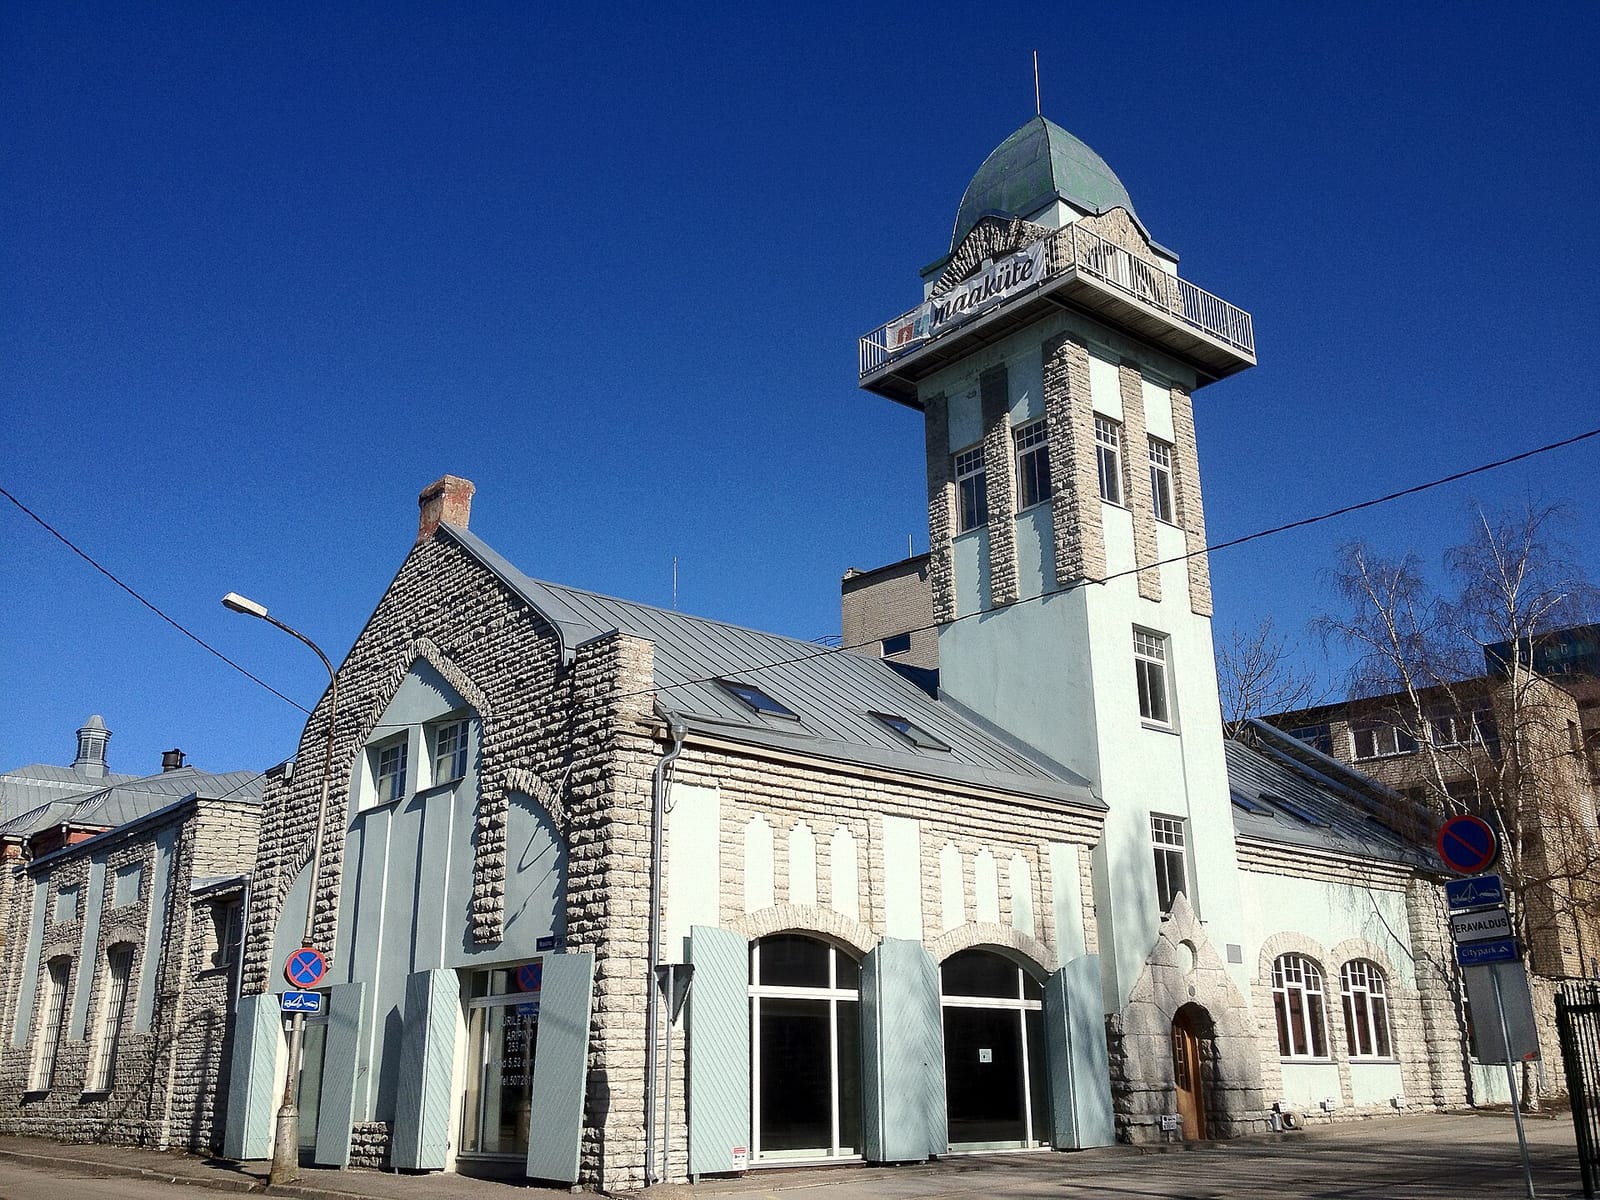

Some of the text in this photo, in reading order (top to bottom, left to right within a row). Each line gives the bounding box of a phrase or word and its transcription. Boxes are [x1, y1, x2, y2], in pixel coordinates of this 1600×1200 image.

[932, 259, 1033, 327] maaküte
[1455, 918, 1507, 933] ERAVALDUS
[1461, 945, 1497, 958] Citypark
